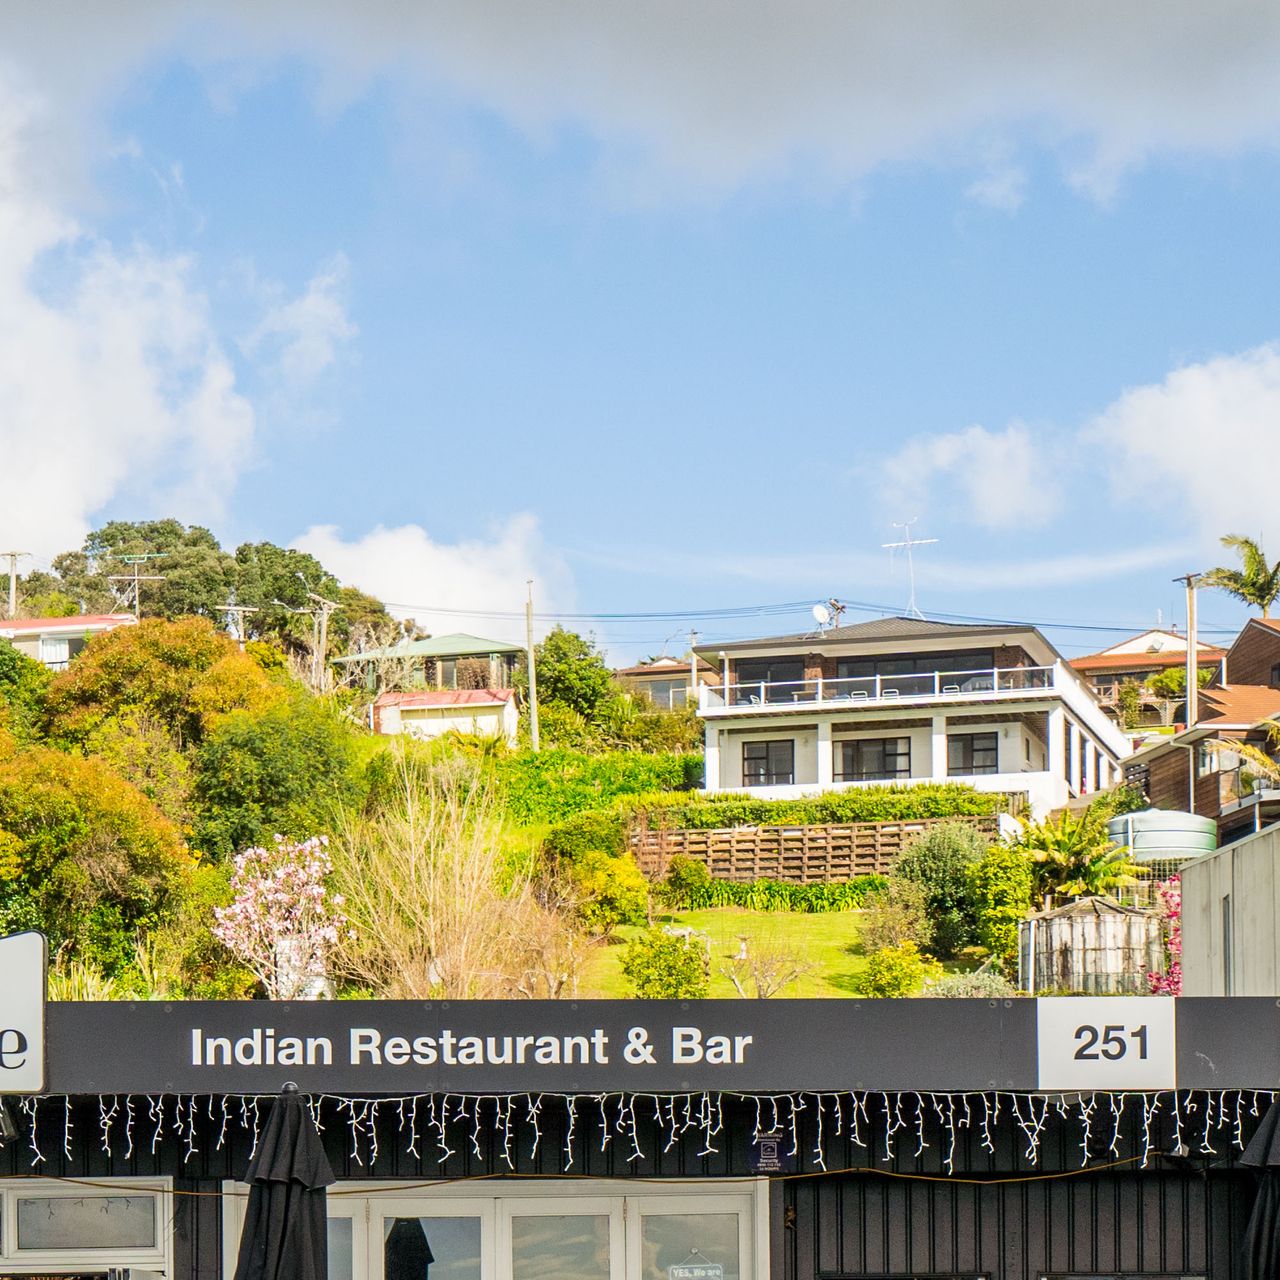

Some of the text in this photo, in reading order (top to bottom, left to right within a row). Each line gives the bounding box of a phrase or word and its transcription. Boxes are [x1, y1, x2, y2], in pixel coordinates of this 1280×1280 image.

[192, 1027, 753, 1067] Indian Restaurant & Bar
[1073, 1025, 1152, 1061] 251
[693, 1268, 706, 1277] We
[706, 1268, 721, 1277] are
